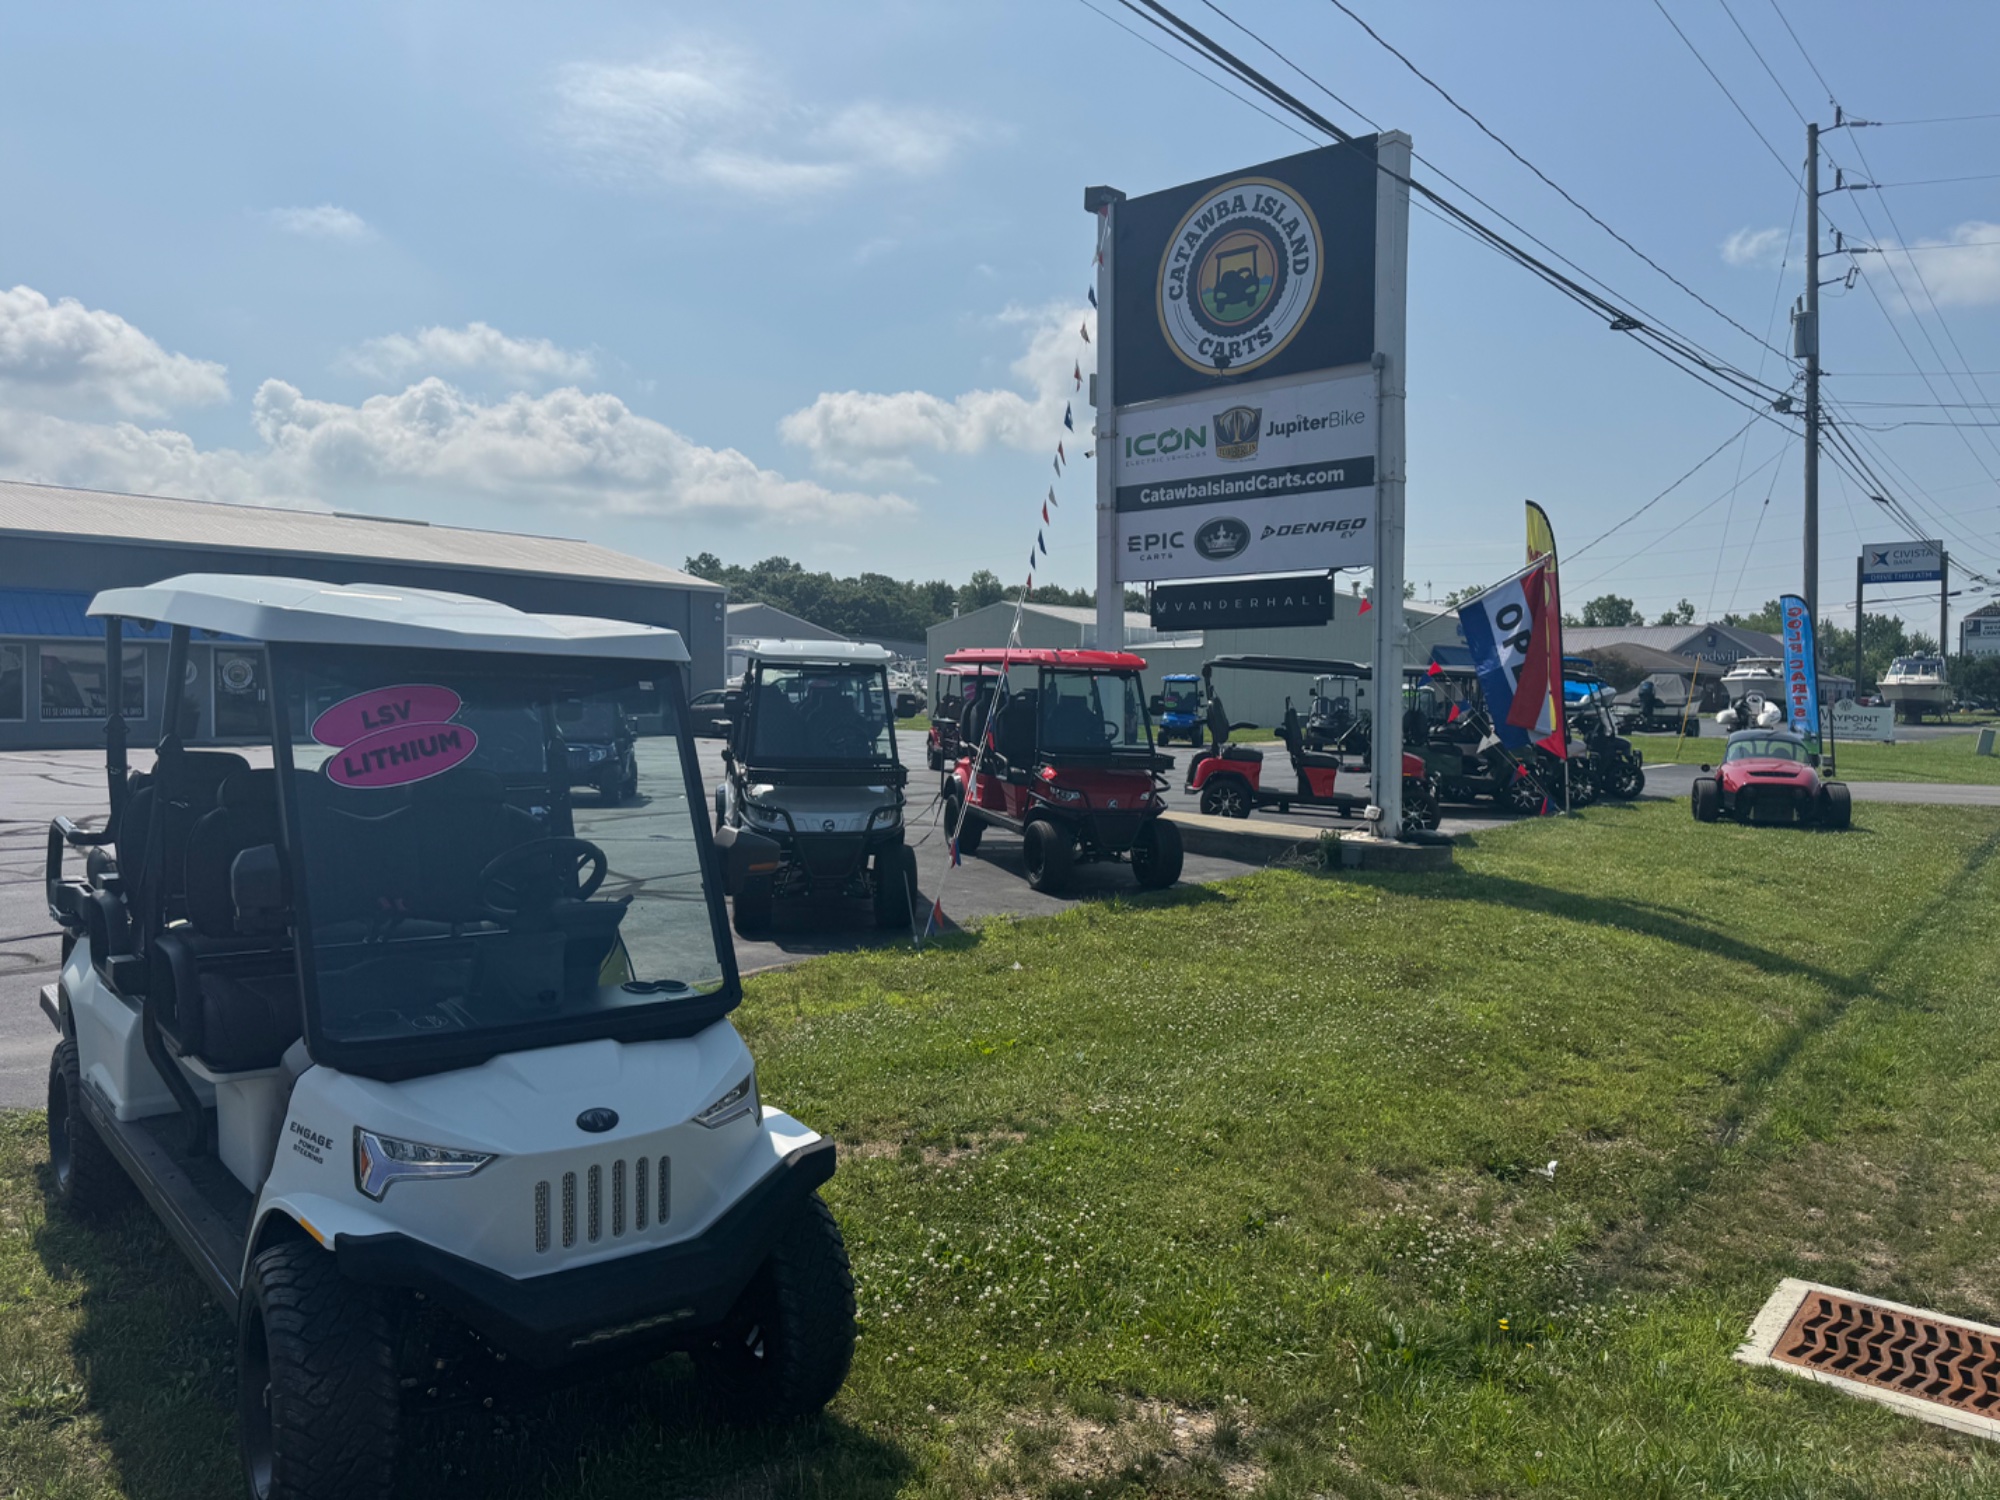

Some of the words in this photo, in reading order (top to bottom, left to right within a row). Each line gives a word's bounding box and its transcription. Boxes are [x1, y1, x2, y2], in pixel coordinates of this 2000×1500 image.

[1168, 194, 1247, 301] CATAWBA
[1252, 193, 1309, 276] ISLAND
[1198, 325, 1274, 360] CARTS
[1266, 409, 1365, 438] JupiterBike
[1126, 425, 1207, 459] ICON
[1126, 456, 1164, 467] ELECTRIC
[1166, 451, 1207, 461] VEHICLES
[1140, 468, 1345, 503] CatawbaIslandCarts.com
[1276, 517, 1367, 537] DENAGO
[1340, 530, 1357, 539] EV
[1127, 531, 1185, 552] EPIC
[1140, 553, 1173, 561] CARTS
[1893, 548, 1934, 558] CIVISTA
[1871, 573, 1891, 581] DRIVE
[1175, 595, 1327, 612] VANDERHALL
[1681, 649, 1739, 662] Goodwill
[361, 700, 412, 730] LSV
[343, 730, 462, 779] LITHIUM
[290, 1121, 334, 1150] ENGAGE
[298, 1138, 320, 1154] POWER
[293, 1143, 324, 1165] STEERING
